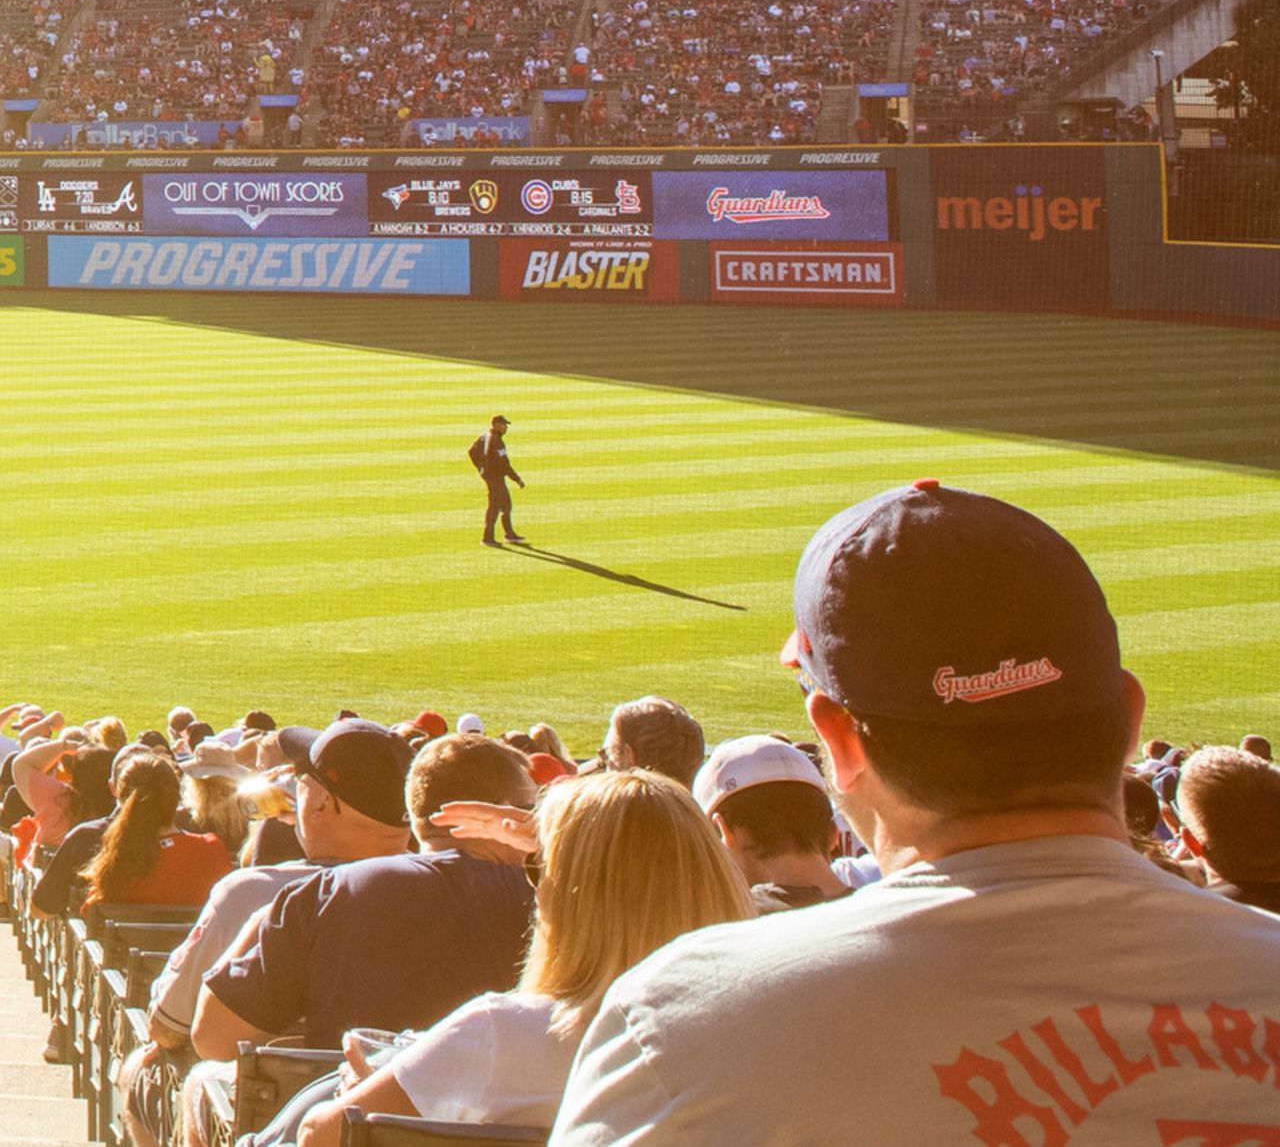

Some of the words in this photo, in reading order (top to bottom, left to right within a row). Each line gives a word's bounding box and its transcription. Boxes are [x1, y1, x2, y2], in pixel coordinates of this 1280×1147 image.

[42, 157, 104, 169] PROGRESSIVE
[126, 157, 189, 168] PROGRESSIVE
[212, 156, 279, 168] PROGRESSIVE
[303, 156, 371, 168] PROGRESSIVE
[394, 156, 467, 168] PROGRESSIVE
[490, 155, 564, 166] PROGRESSIVE
[589, 154, 666, 166] PROGRESSIVE
[692, 154, 770, 166] PROGRESSIVE
[800, 152, 881, 164] PROGRESSIVE
[59, 180, 99, 191] DODGERS
[410, 180, 436, 190] BLUE
[437, 180, 461, 190] JAYS
[552, 180, 580, 191] CUBS
[164, 181, 197, 202] OUT
[202, 181, 229, 202] OF
[233, 181, 281, 202] TOWN
[285, 181, 344, 203] SCORES
[80, 205, 113, 215] BRAVES
[707, 187, 831, 223] Guardians
[434, 207, 471, 217] BREWERS
[578, 207, 617, 217] CARDINALS
[939, 185, 1102, 241] meijer
[448, 223, 488, 234] HOUSER
[591, 223, 633, 235] PALLANTE
[78, 241, 425, 291] PROGRESSIVE
[522, 250, 651, 290] BLASTER
[726, 261, 884, 284] CRAFTSMAN
[933, 657, 1062, 704] Guardians
[931, 1000, 1280, 1147] BILLAB
